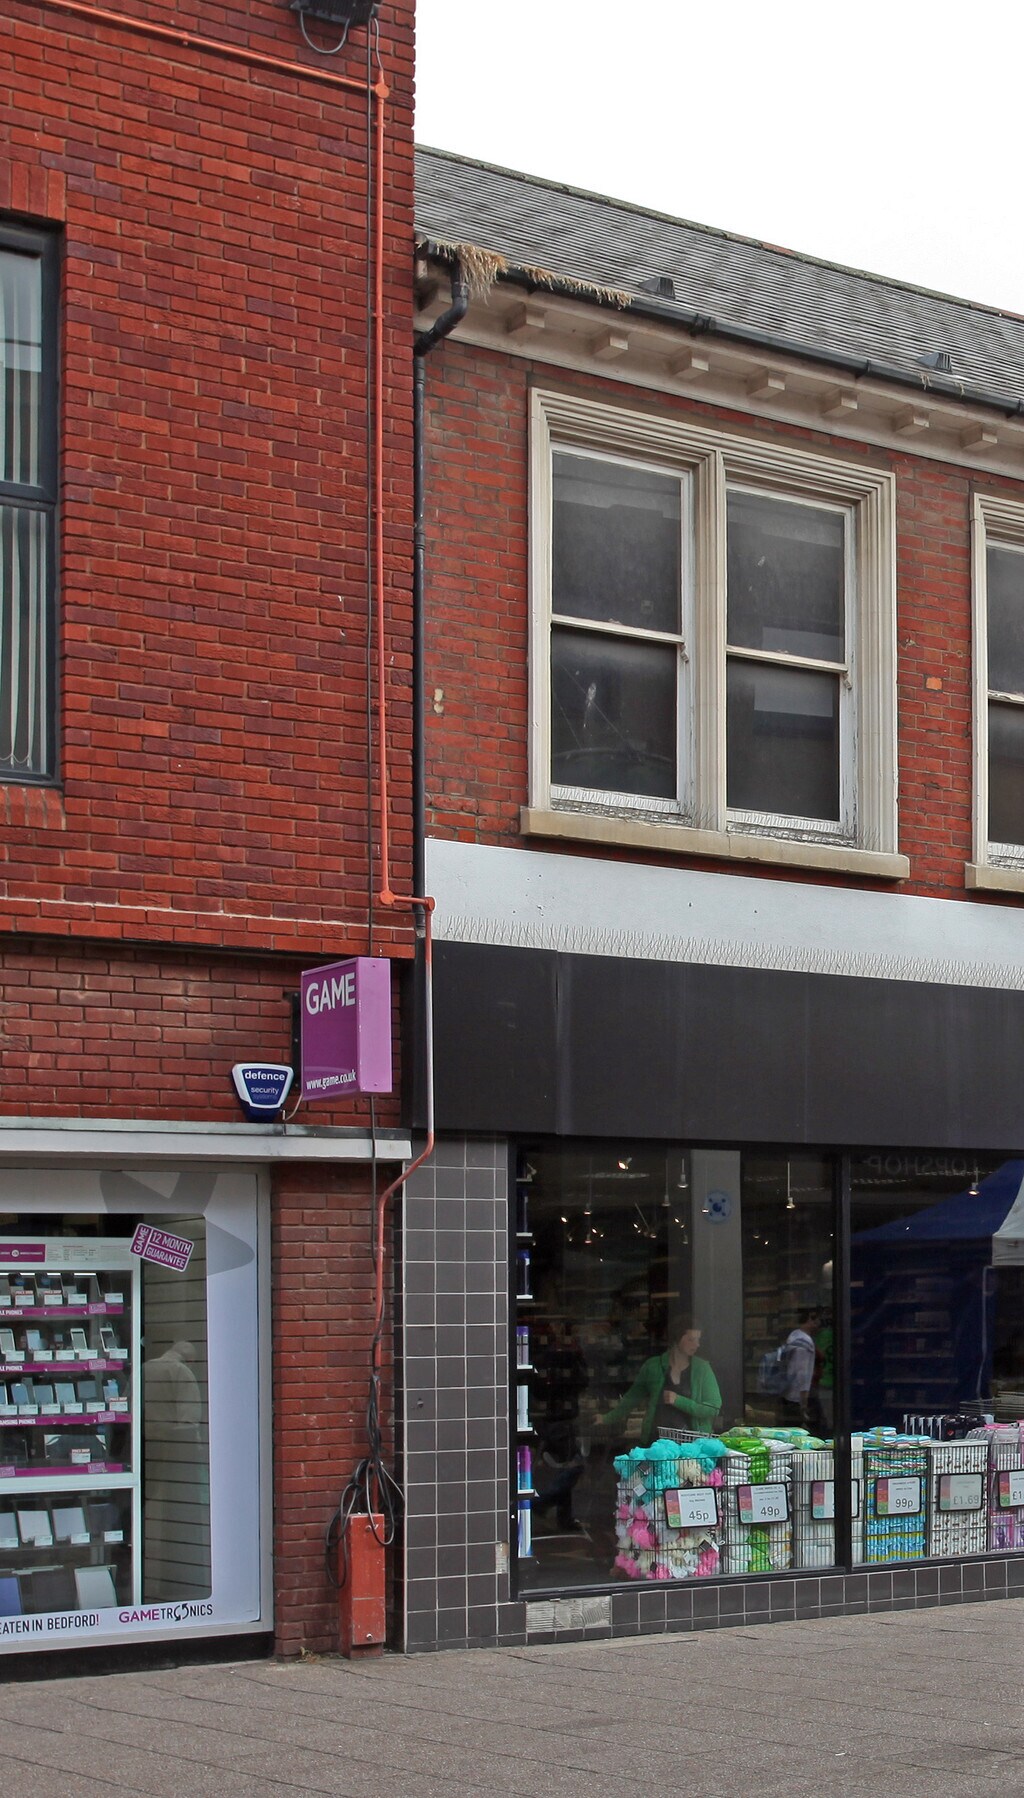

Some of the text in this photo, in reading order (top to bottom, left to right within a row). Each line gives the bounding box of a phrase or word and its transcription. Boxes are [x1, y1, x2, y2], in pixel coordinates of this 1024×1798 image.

[306, 972, 356, 1015] GAME
[244, 1070, 286, 1081] defence
[306, 1069, 357, 1090] www.game.co.uk
[250, 1086, 280, 1096] security
[133, 1226, 149, 1253] GAME
[152, 1232, 192, 1254] 12 MONTH
[146, 1247, 186, 1268] GUARANTEE
[895, 1498, 913, 1509] 99p
[953, 1494, 980, 1506] £1.69
[689, 1510, 709, 1522] 45p
[760, 1506, 780, 1517] 49p
[0, 1613, 100, 1635] ATEN IN BEDFORD!
